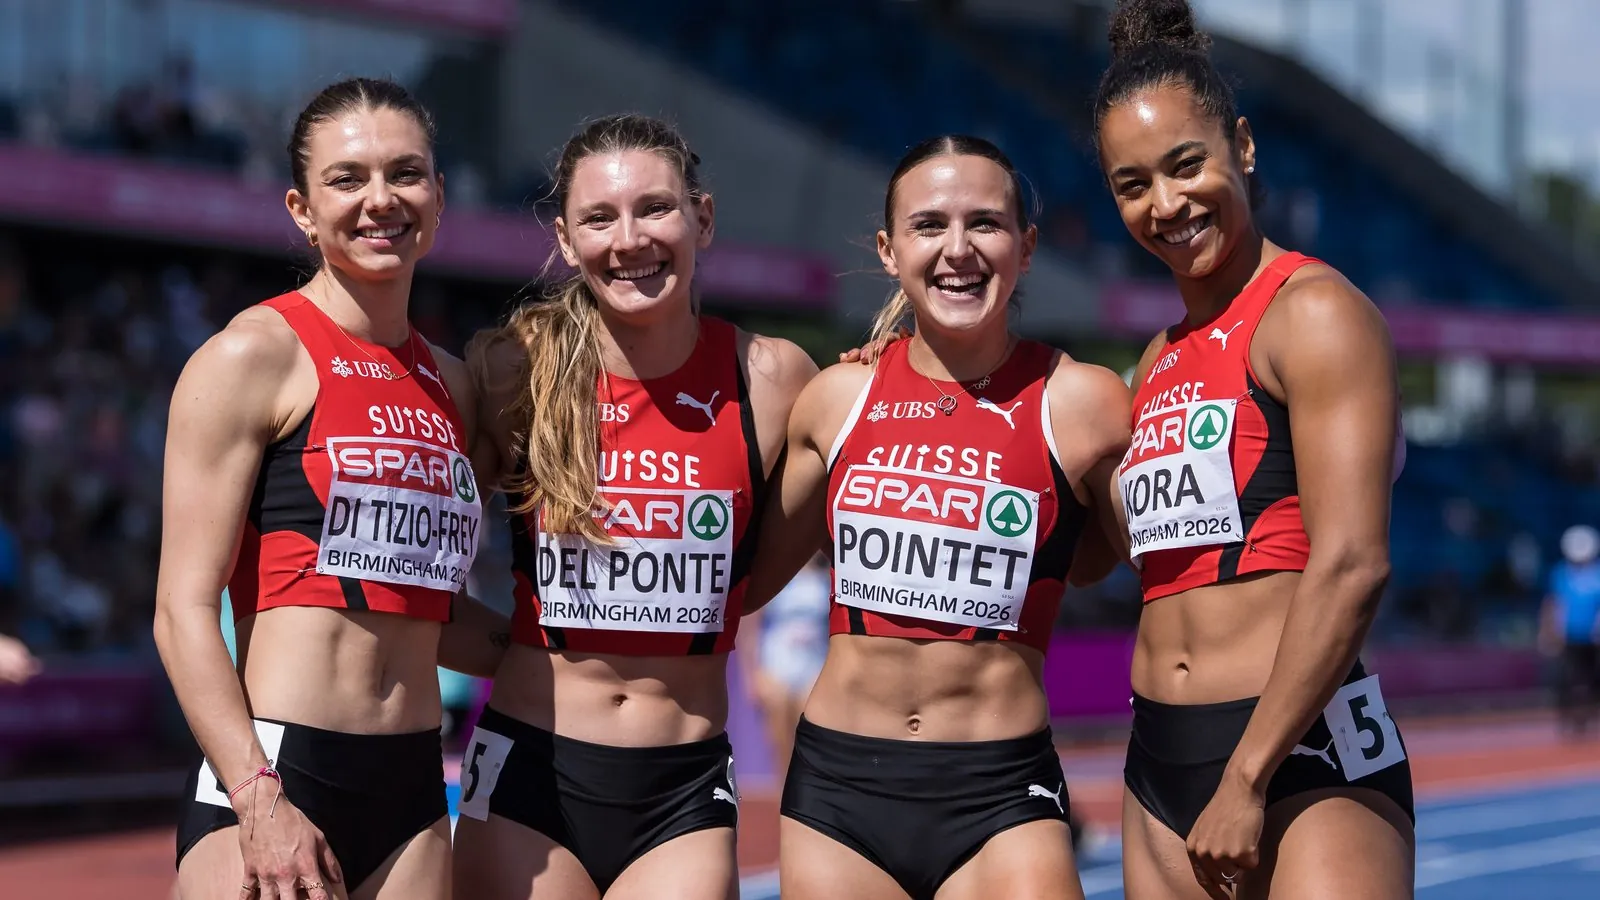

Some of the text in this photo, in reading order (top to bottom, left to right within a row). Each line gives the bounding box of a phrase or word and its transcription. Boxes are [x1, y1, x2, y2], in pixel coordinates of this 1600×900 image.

[352, 361, 393, 380] UBS
[1157, 349, 1181, 373] UBS
[597, 403, 630, 422] BS
[892, 401, 936, 419] UBS
[339, 448, 449, 489] SPAR
[844, 476, 978, 523] SPAR
[1125, 464, 1205, 524] KORA
[328, 496, 478, 558] DI TIZIO-FREY
[1131, 516, 1232, 548] NGHAM 2026
[327, 550, 447, 581] BIRMINGHAM
[540, 547, 726, 594] DEL PONTE
[839, 523, 1028, 590] POINTET
[543, 601, 719, 624] BIRMINGHAM 2026
[841, 578, 1012, 621] BIRMINGHAM 2026
[1348, 693, 1385, 760] 5
[463, 742, 488, 803] 5
